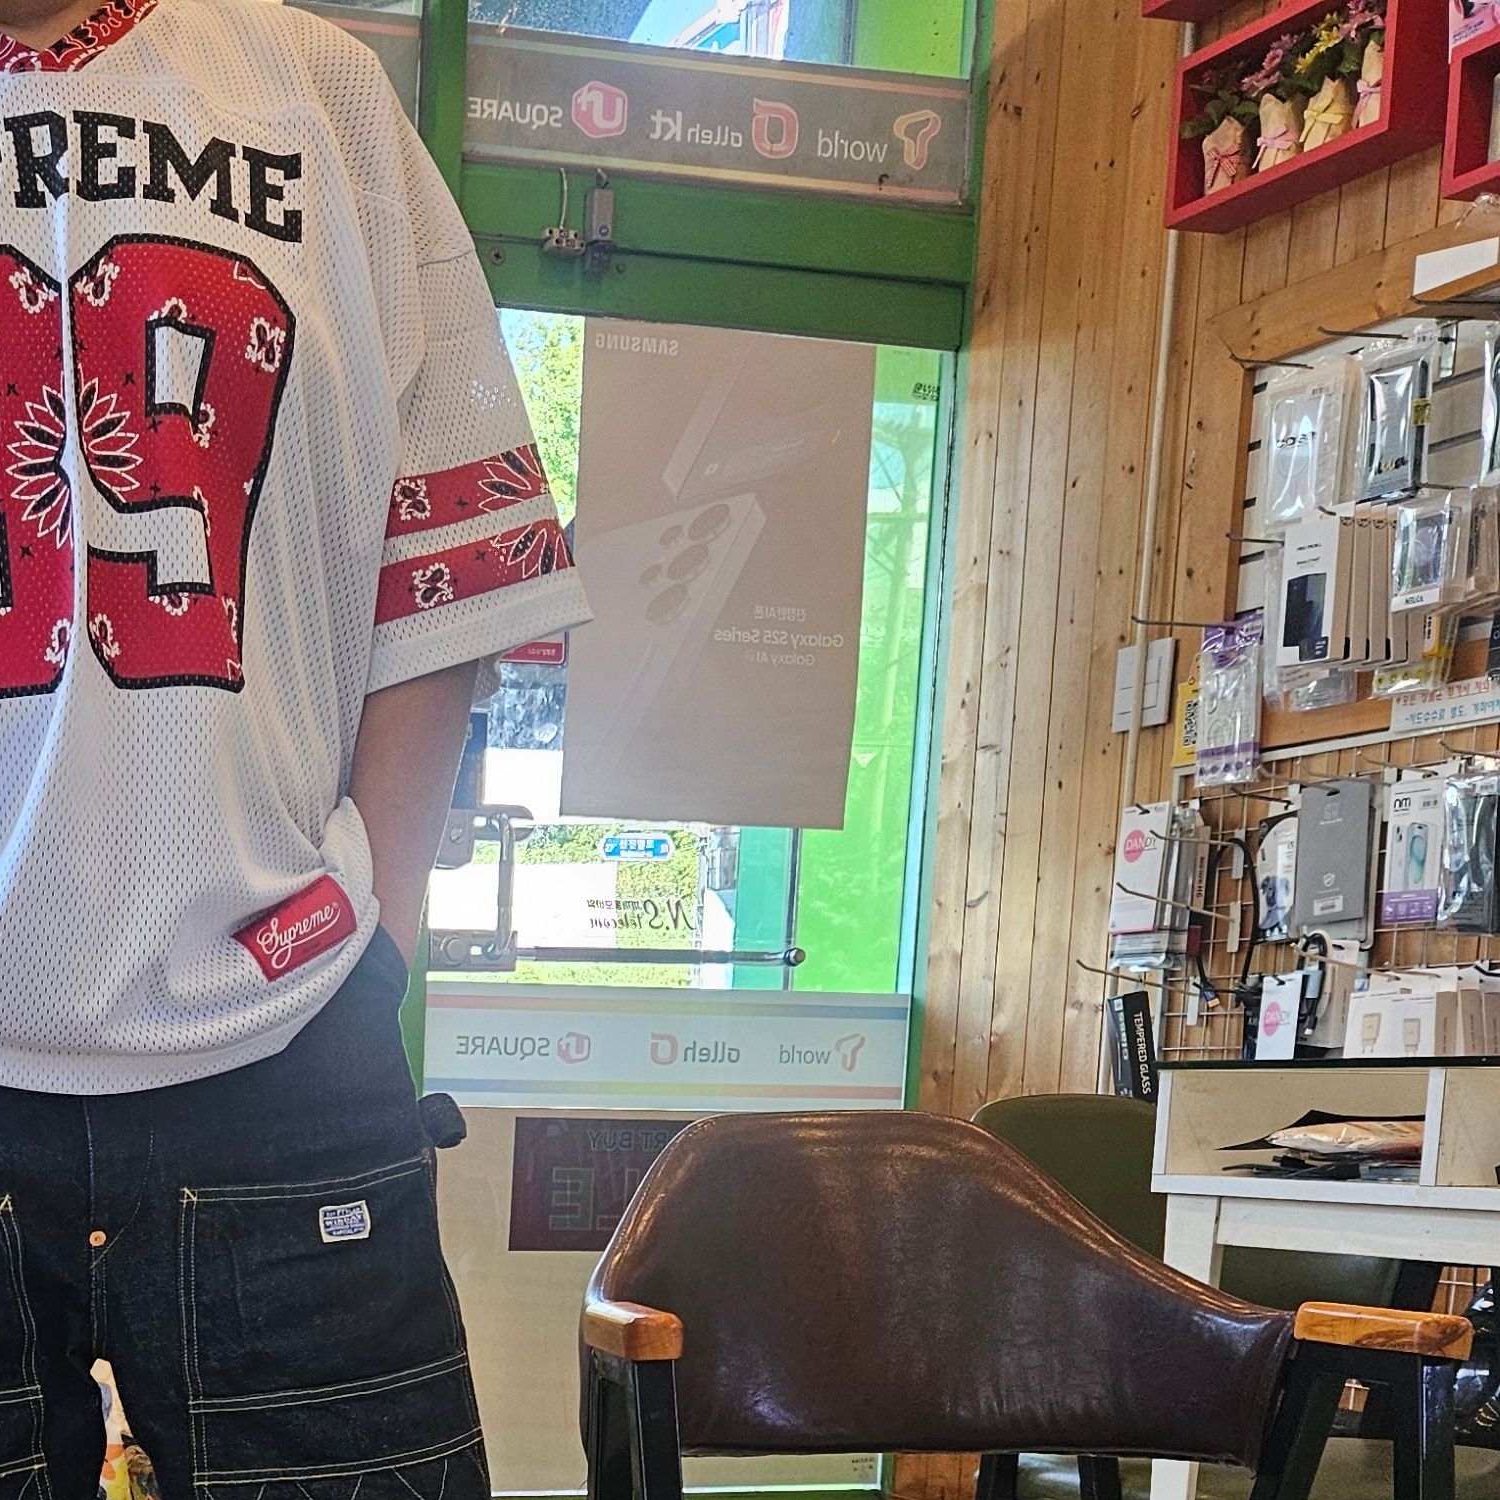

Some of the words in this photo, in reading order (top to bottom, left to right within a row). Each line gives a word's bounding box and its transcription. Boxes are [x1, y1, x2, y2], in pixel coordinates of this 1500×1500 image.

[1125, 835, 1157, 851] DANDY
[256, 903, 341, 969] Supreme
[1133, 1011, 1149, 1063] TEMPERED
[1139, 1064, 1152, 1095] GLASS
